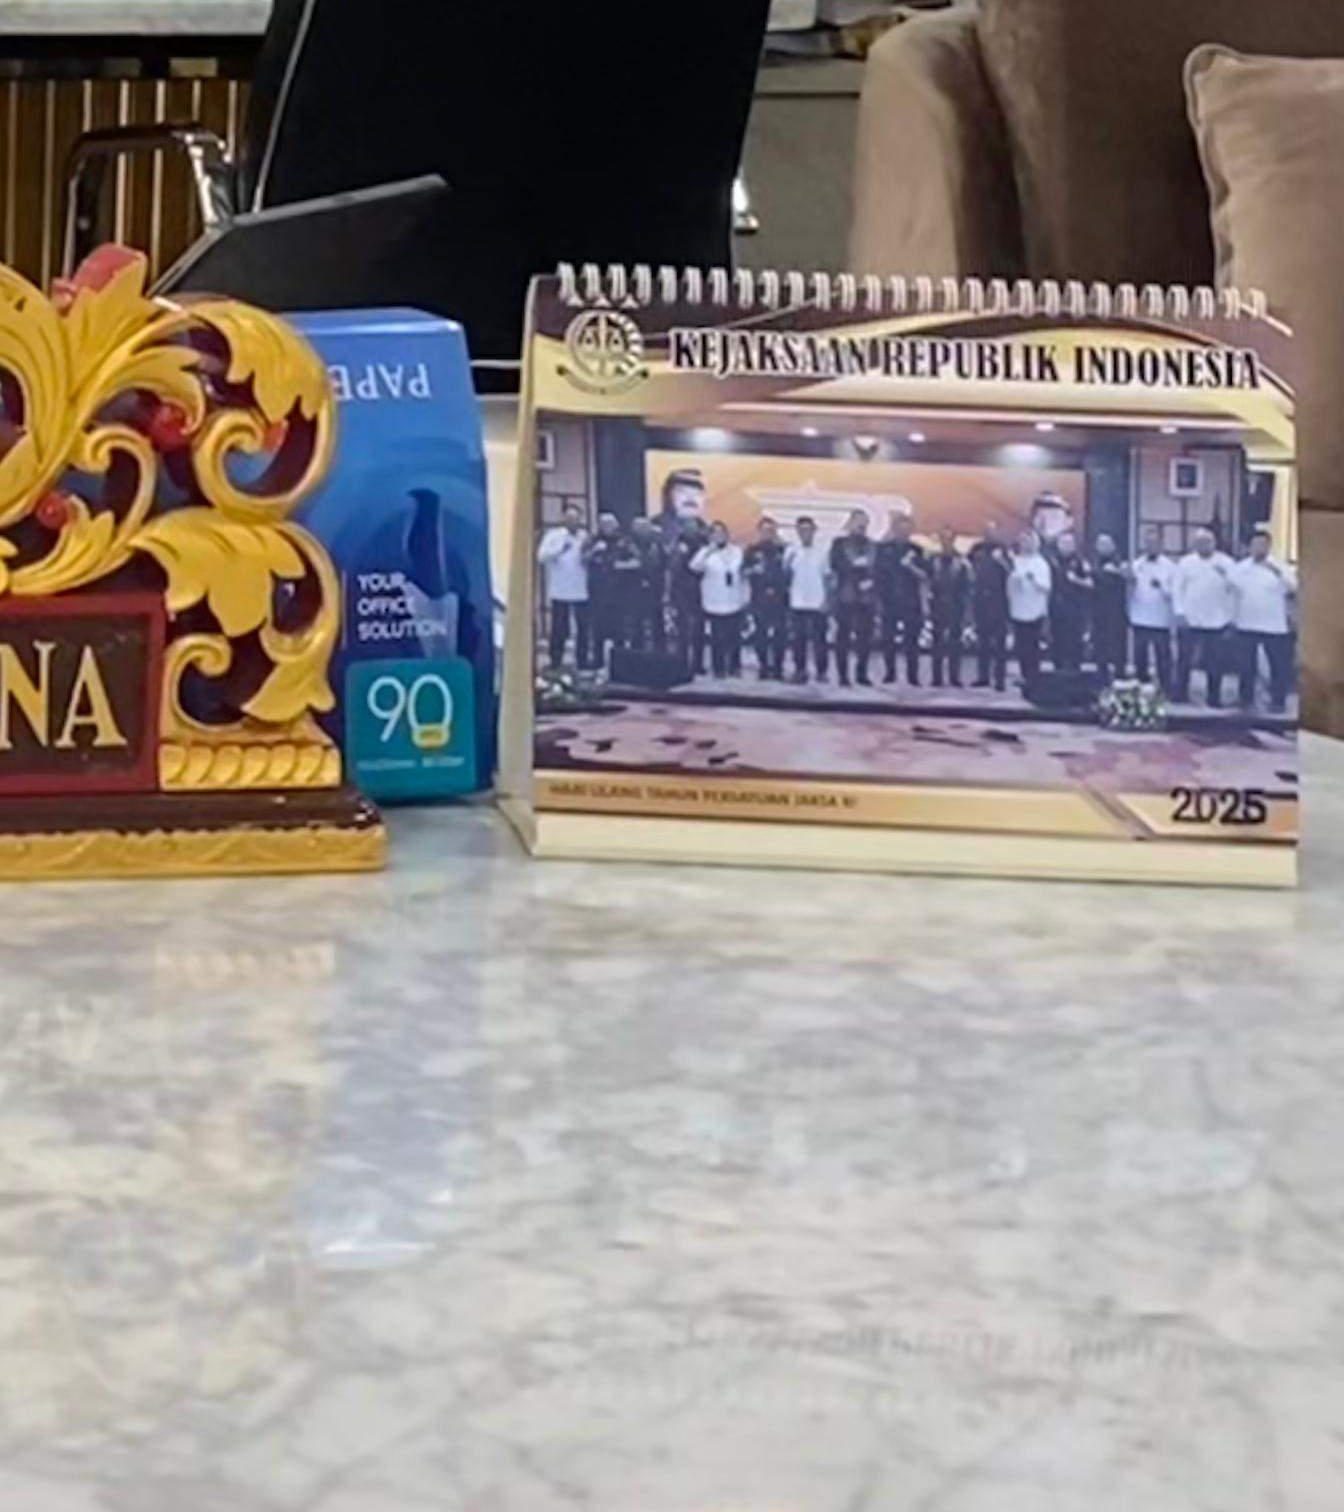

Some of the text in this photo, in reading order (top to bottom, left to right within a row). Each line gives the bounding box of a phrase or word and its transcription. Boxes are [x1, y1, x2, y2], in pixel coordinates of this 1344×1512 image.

[670, 328, 1261, 390] KEJAKSAAN REPUBLIK INDONESIA
[328, 363, 432, 401] PAPE
[356, 595, 415, 616] OFFICE
[357, 619, 448, 641] SOLUTION
[367, 673, 453, 749] 90
[1171, 787, 1267, 824] 2025
